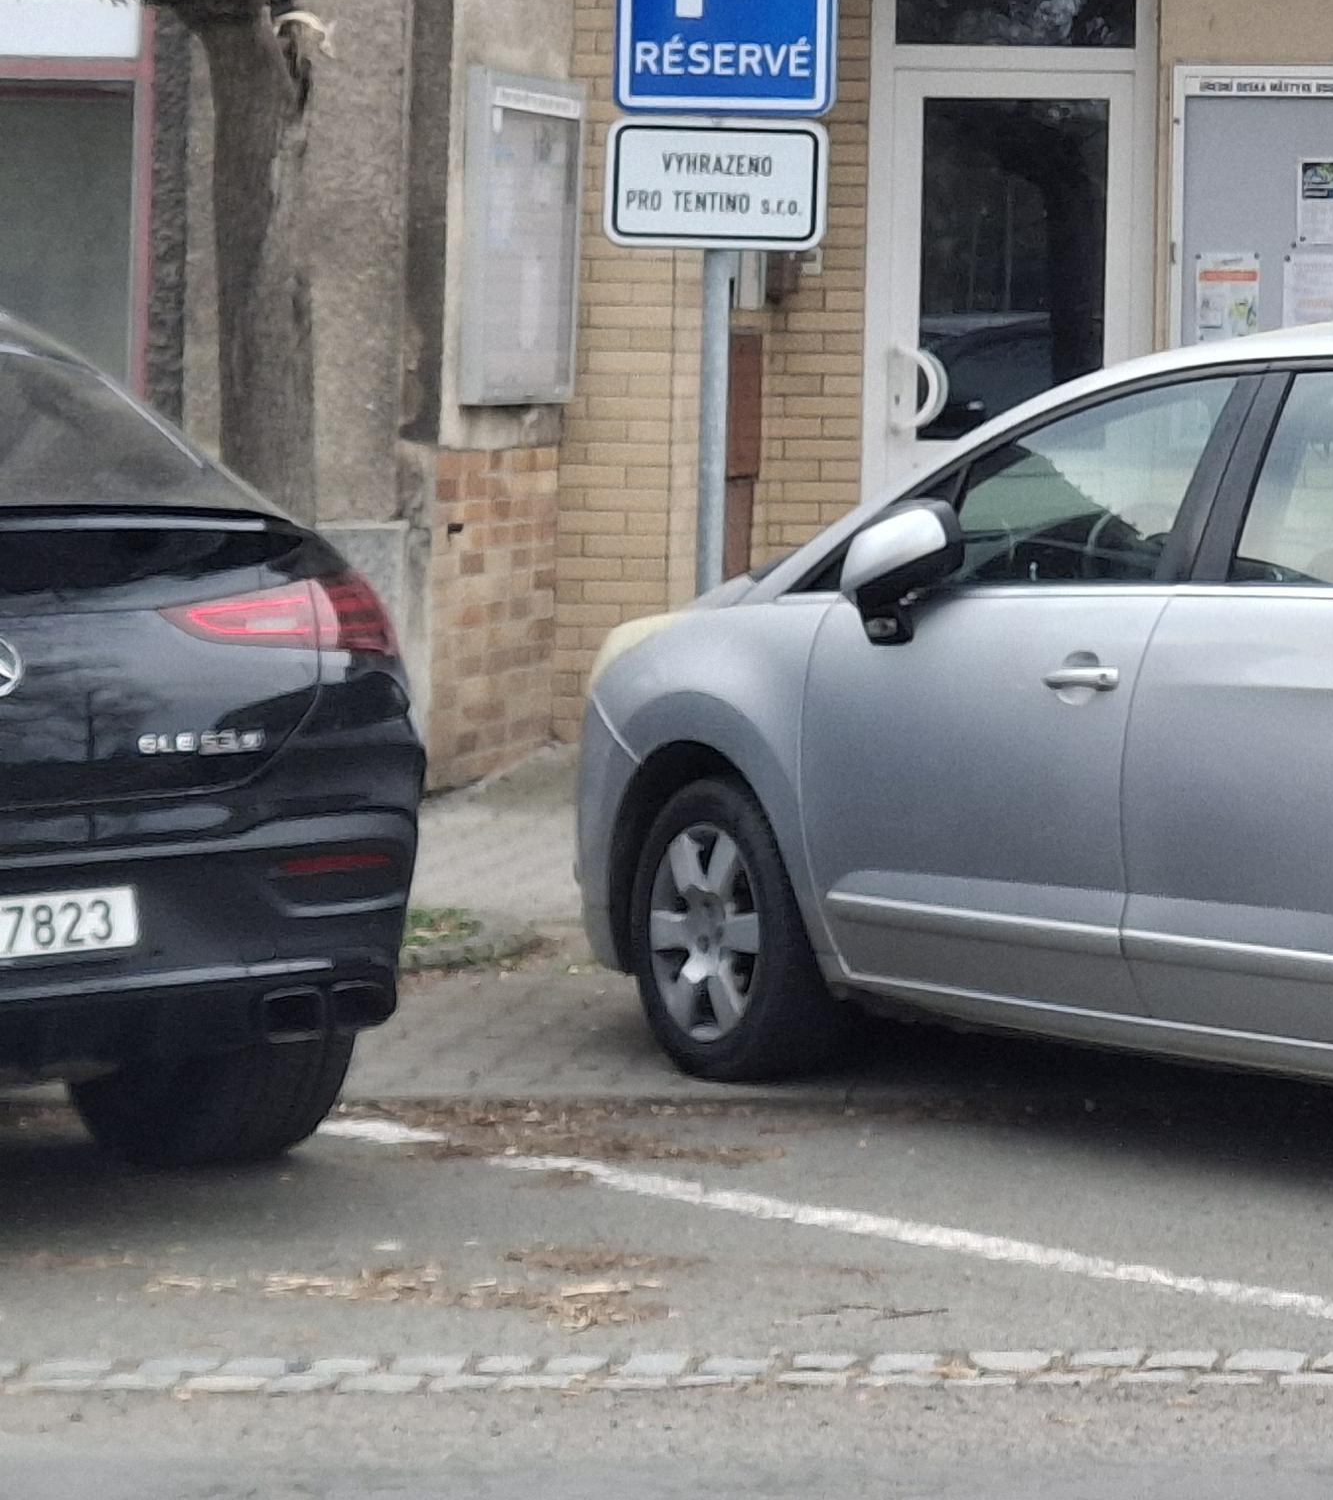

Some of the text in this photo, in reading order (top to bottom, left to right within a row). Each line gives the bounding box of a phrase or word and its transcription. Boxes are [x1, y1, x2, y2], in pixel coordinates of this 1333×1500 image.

[633, 33, 812, 78] RÉSERVÉ
[661, 152, 773, 177] VYHRAZENO
[625, 188, 803, 216] PRO TENTINO s.r.o.
[2, 899, 113, 954] 7823
